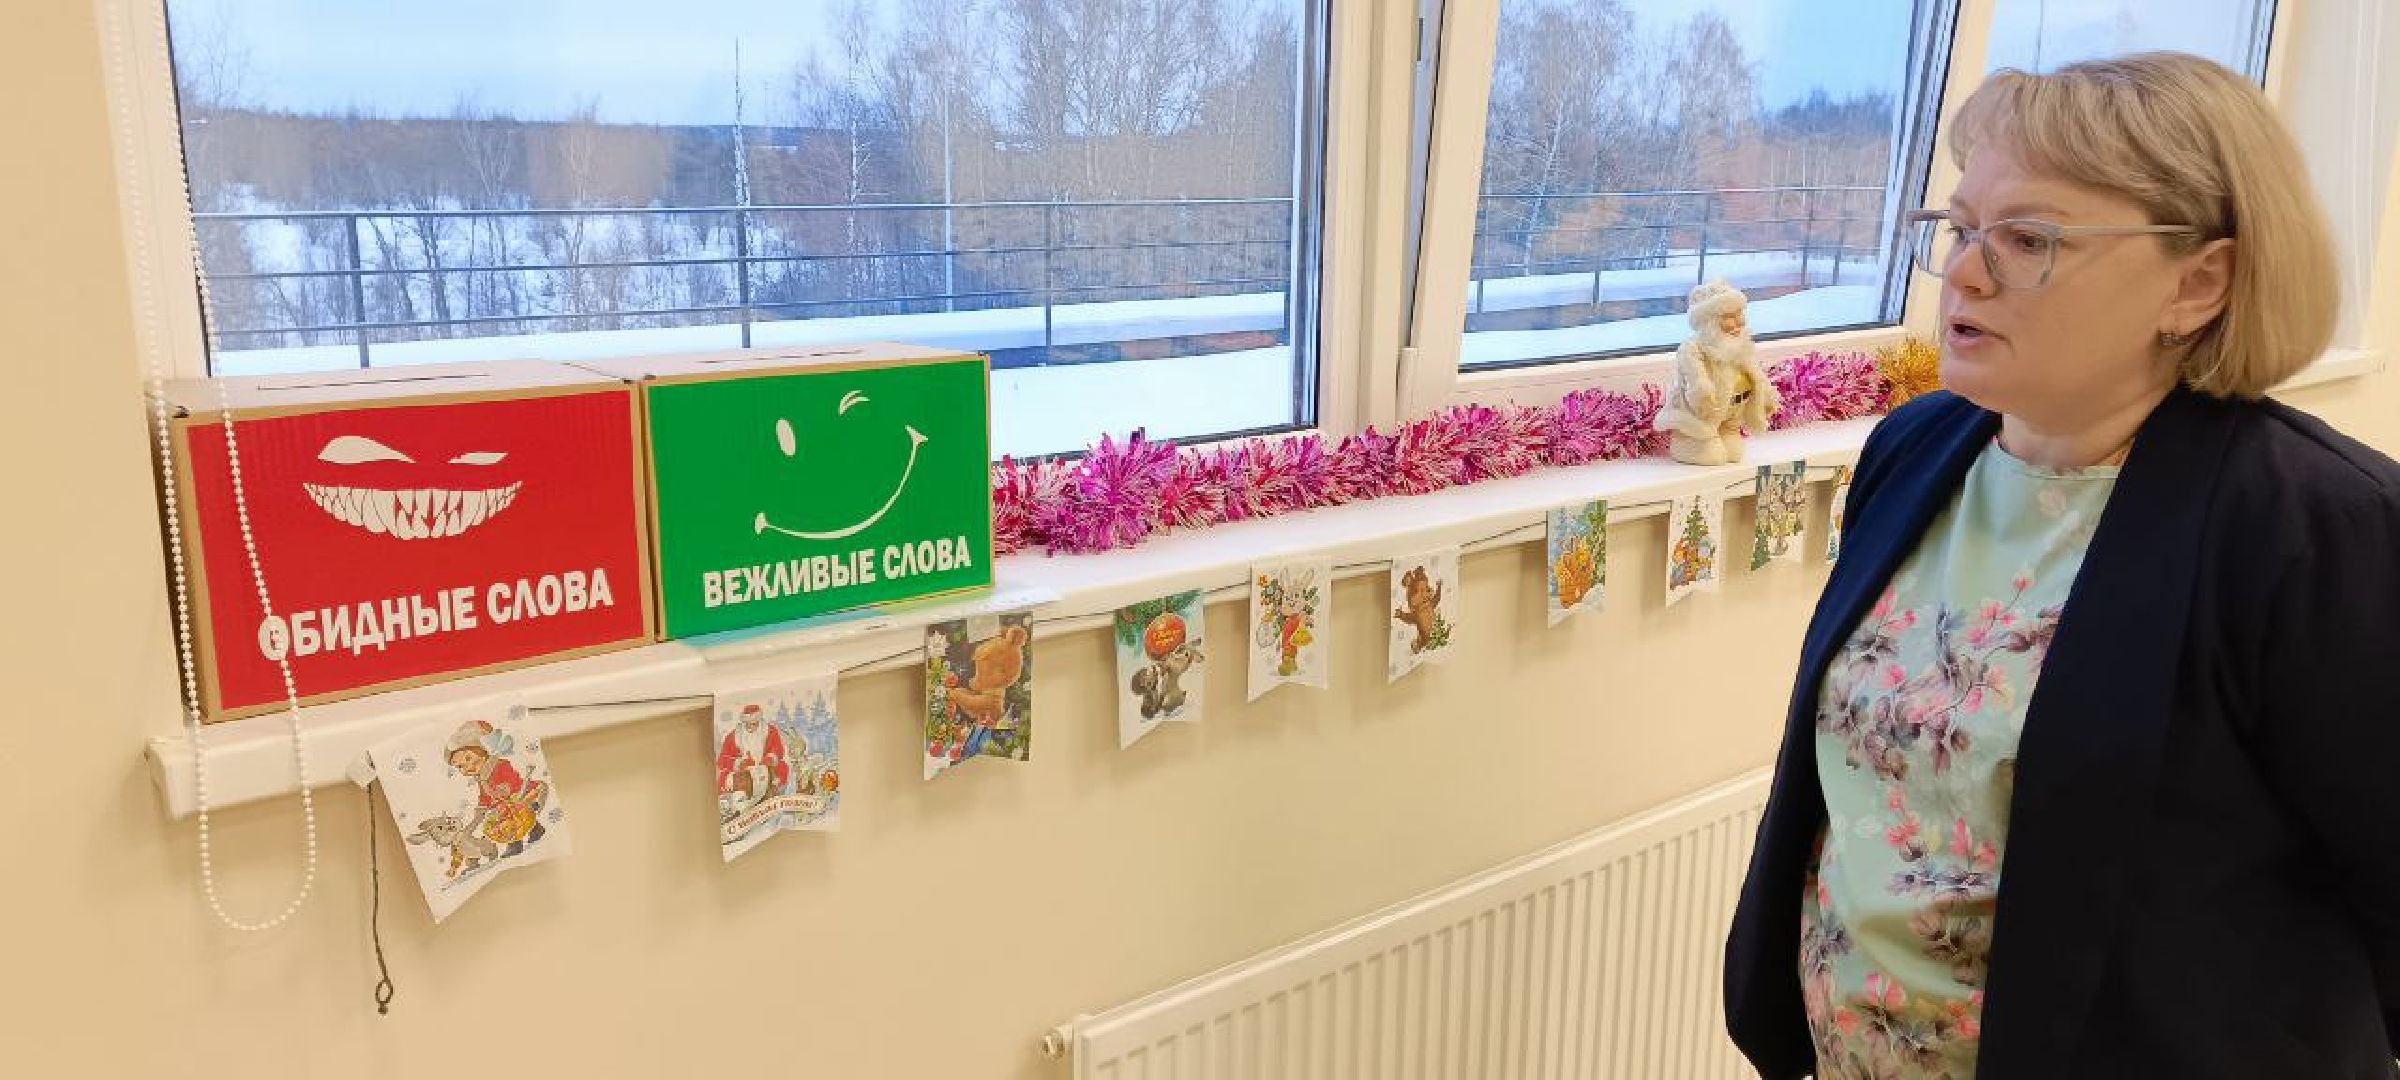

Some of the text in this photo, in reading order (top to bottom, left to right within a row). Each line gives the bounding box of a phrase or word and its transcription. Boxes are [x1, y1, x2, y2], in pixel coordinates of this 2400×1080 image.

[703, 535, 972, 608] ВЕЖЛИВЫЕ СЛОВА
[258, 567, 614, 661] ОБИДНЫЕ СЛОВА
